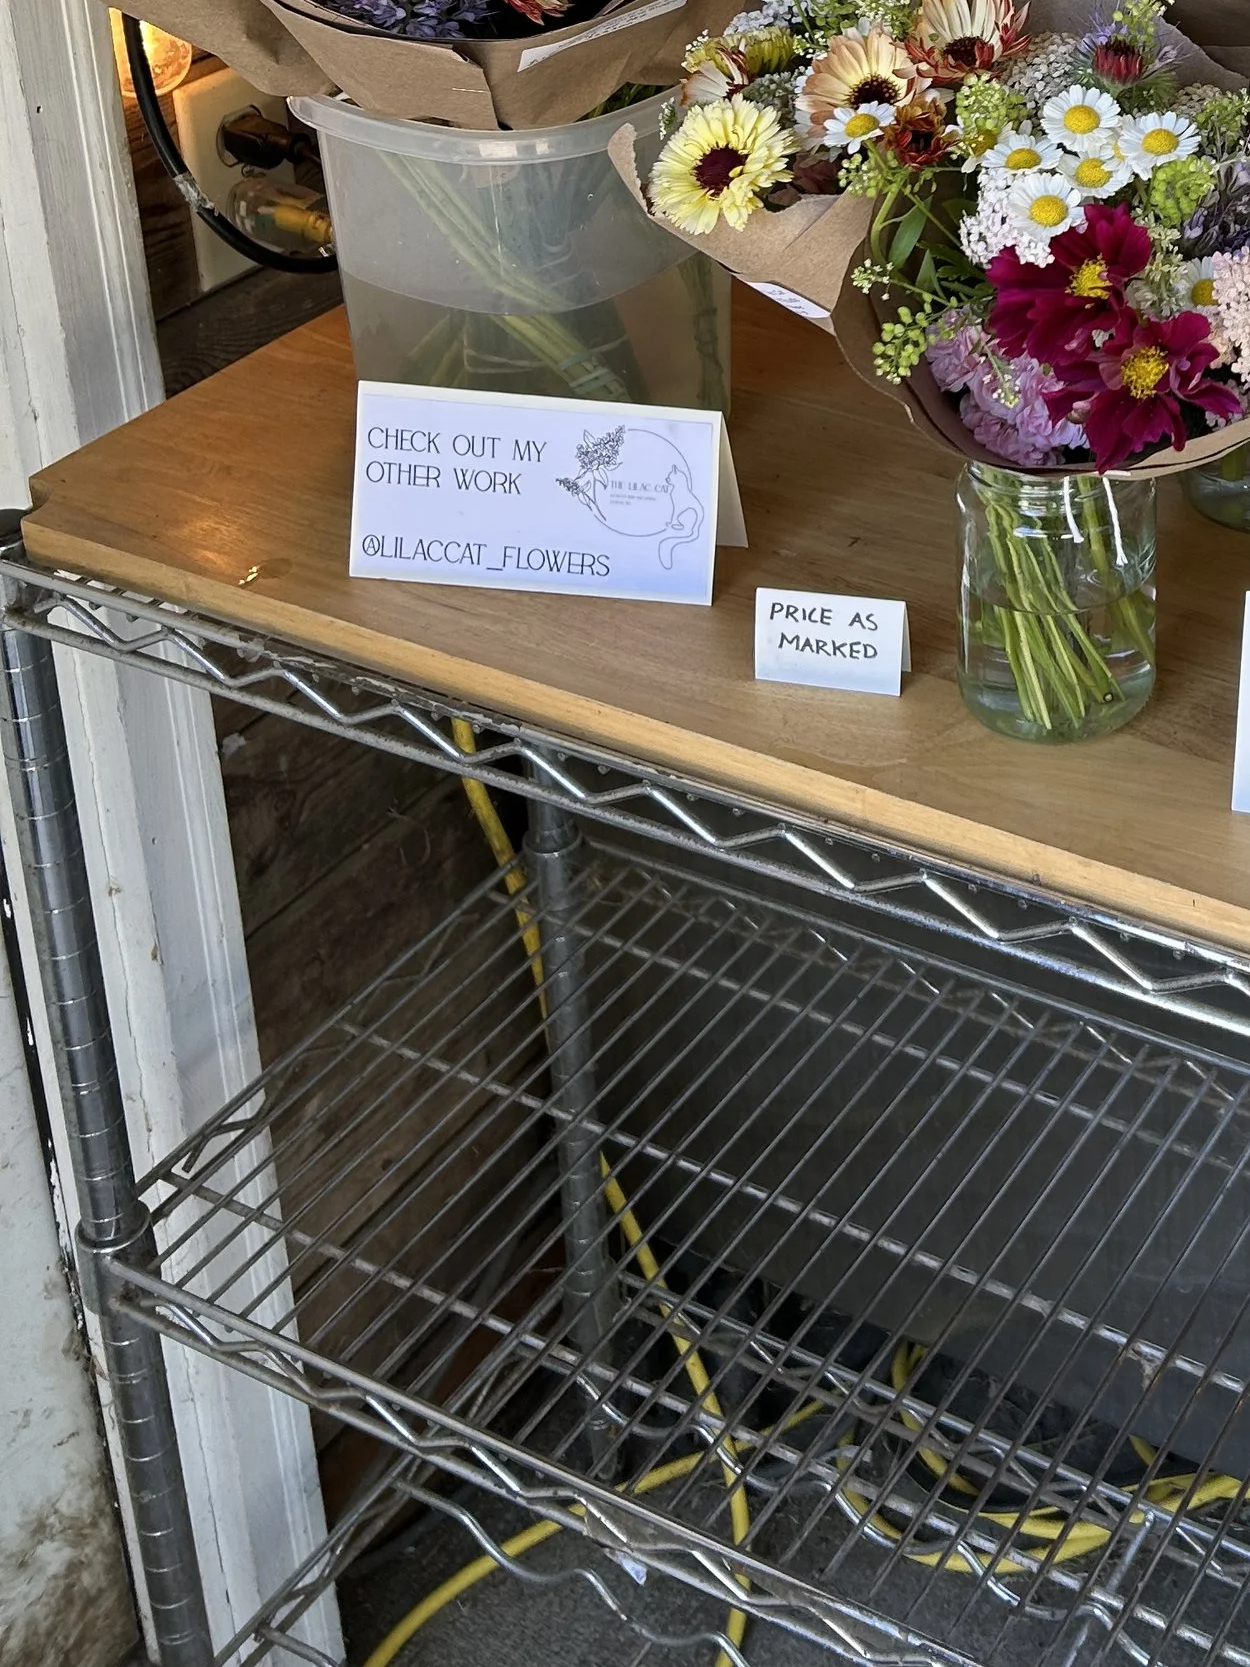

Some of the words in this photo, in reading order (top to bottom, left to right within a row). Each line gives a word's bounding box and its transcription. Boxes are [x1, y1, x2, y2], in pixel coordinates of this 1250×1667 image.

[367, 426, 441, 454] CHECK
[452, 434, 501, 459] OUT
[512, 439, 547, 462] MY
[366, 460, 441, 488] OTHER
[453, 467, 522, 495] WORK
[362, 534, 610, 577] @LILACCAT_FLOWERS
[769, 602, 833, 626] PRICE
[848, 612, 878, 631] AS
[778, 632, 878, 659] MARKED
